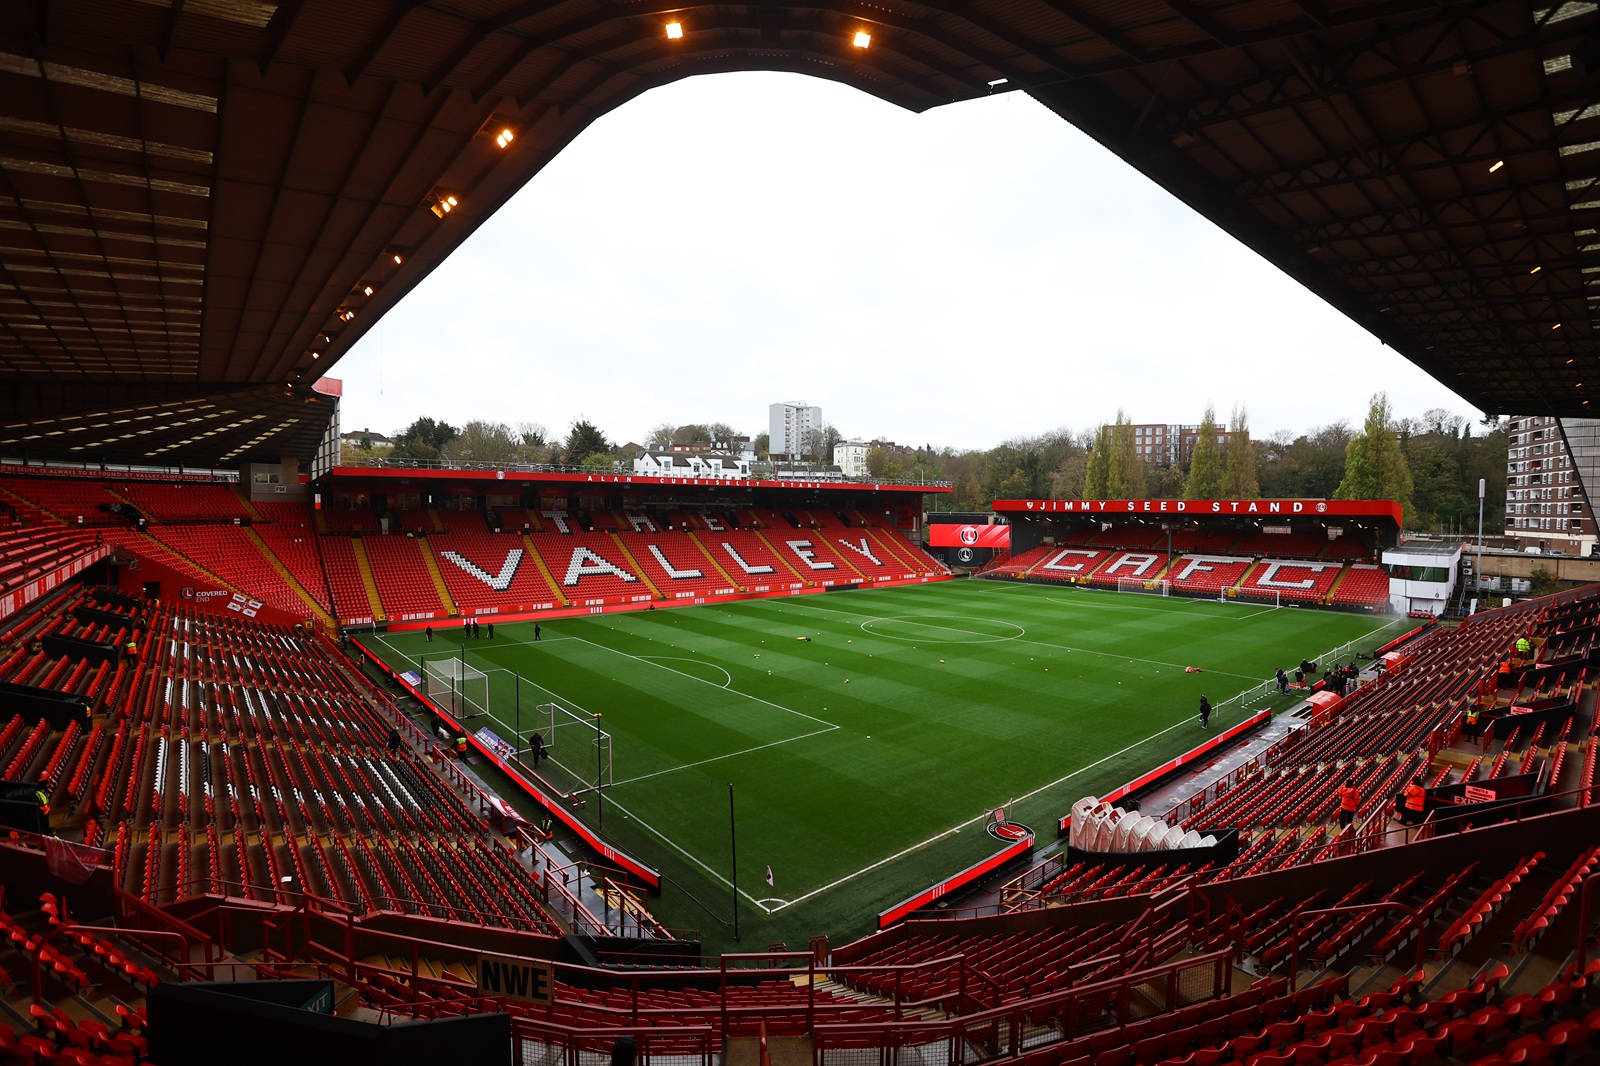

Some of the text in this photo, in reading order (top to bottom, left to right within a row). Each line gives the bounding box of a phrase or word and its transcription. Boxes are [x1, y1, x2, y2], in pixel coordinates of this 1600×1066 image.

[588, 475, 632, 483] ALAN
[660, 478, 760, 488] CURBISHLEY
[1040, 501, 1304, 513] JIMMY SEED STAND
[440, 538, 886, 592] VALLEY
[1043, 549, 1328, 590] CAFC
[482, 959, 549, 1001] NWE
[306, 992, 328, 1013] XIT
